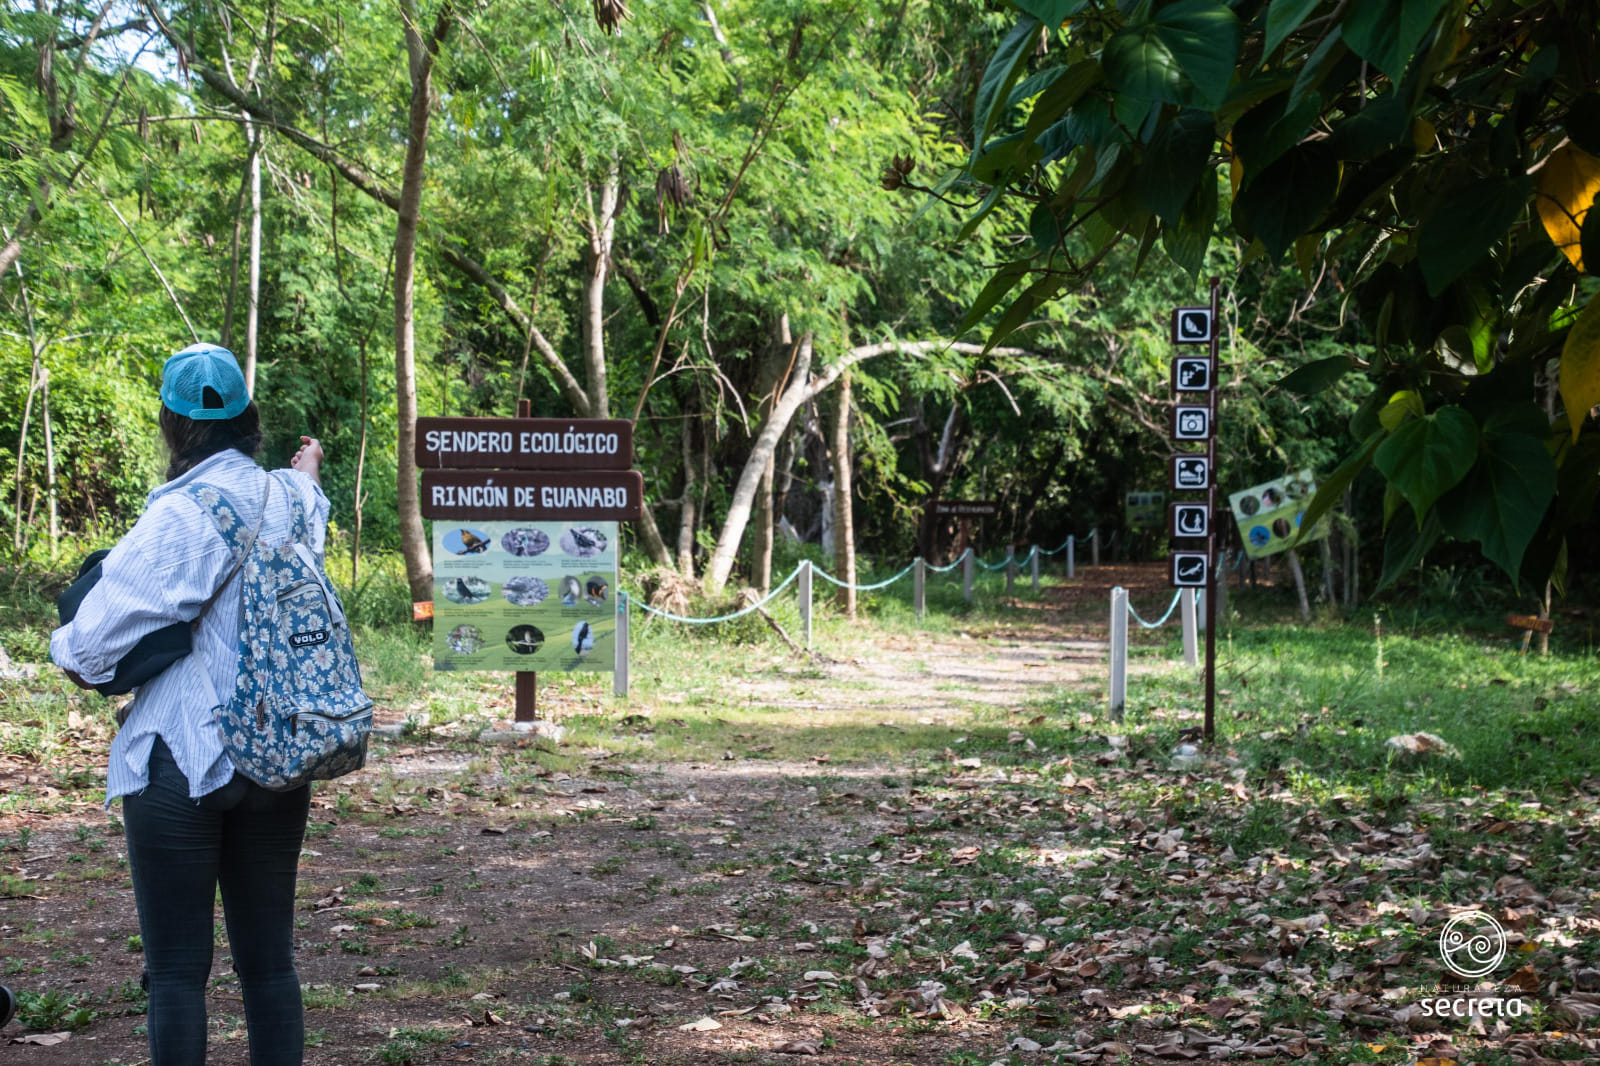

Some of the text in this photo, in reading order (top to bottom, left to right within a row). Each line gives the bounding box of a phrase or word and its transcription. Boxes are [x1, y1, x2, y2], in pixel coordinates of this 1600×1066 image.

[425, 426, 618, 454] SENDERO ECOLÓGICO
[432, 479, 627, 507] RINCÓN DE GUANABO
